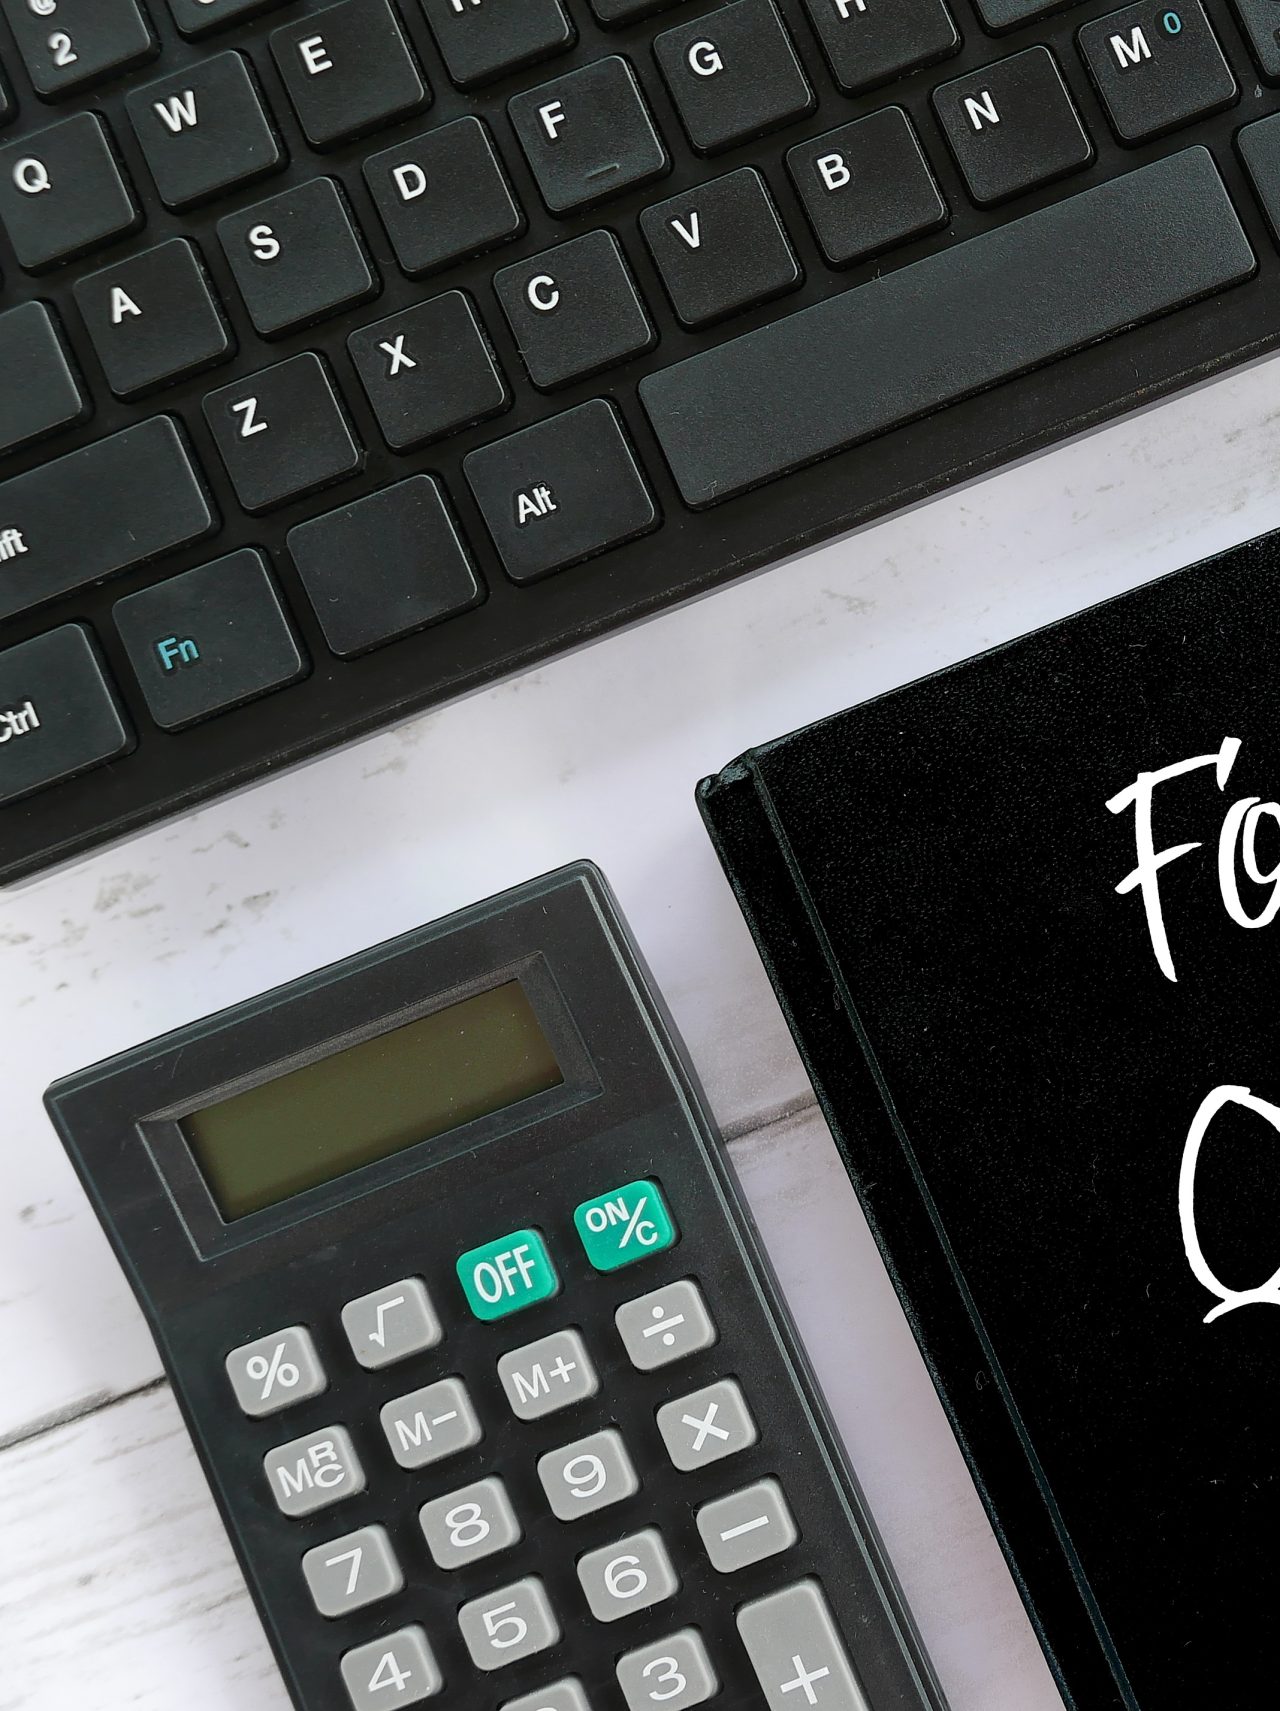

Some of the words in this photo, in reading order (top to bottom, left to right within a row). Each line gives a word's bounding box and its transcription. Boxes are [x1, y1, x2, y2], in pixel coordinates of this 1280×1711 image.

[49, 32, 78, 66] 2
[299, 37, 333, 74] E
[688, 41, 724, 76] G
[1109, 26, 1152, 68] M
[154, 90, 197, 132] W
[538, 100, 565, 139] F
[963, 90, 1000, 130] N
[12, 158, 51, 194] Q
[392, 163, 427, 201] D
[816, 153, 851, 191] B
[248, 224, 280, 260] S
[670, 211, 701, 249] V
[111, 286, 142, 324] A
[527, 275, 560, 311] C
[379, 334, 417, 376] X
[232, 397, 268, 438] Z
[517, 485, 557, 524] Alt
[157, 637, 200, 670] Fn
[474, 1245, 535, 1303] OFF
[246, 1342, 300, 1400] %
[511, 1356, 577, 1404] M+
[563, 1454, 607, 1498] 9
[445, 1502, 490, 1547] 8
[325, 1547, 363, 1595] 7
[604, 1555, 648, 1599] 6
[482, 1601, 528, 1649] 5
[368, 1651, 412, 1692] 4
[642, 1656, 687, 1701] 3
